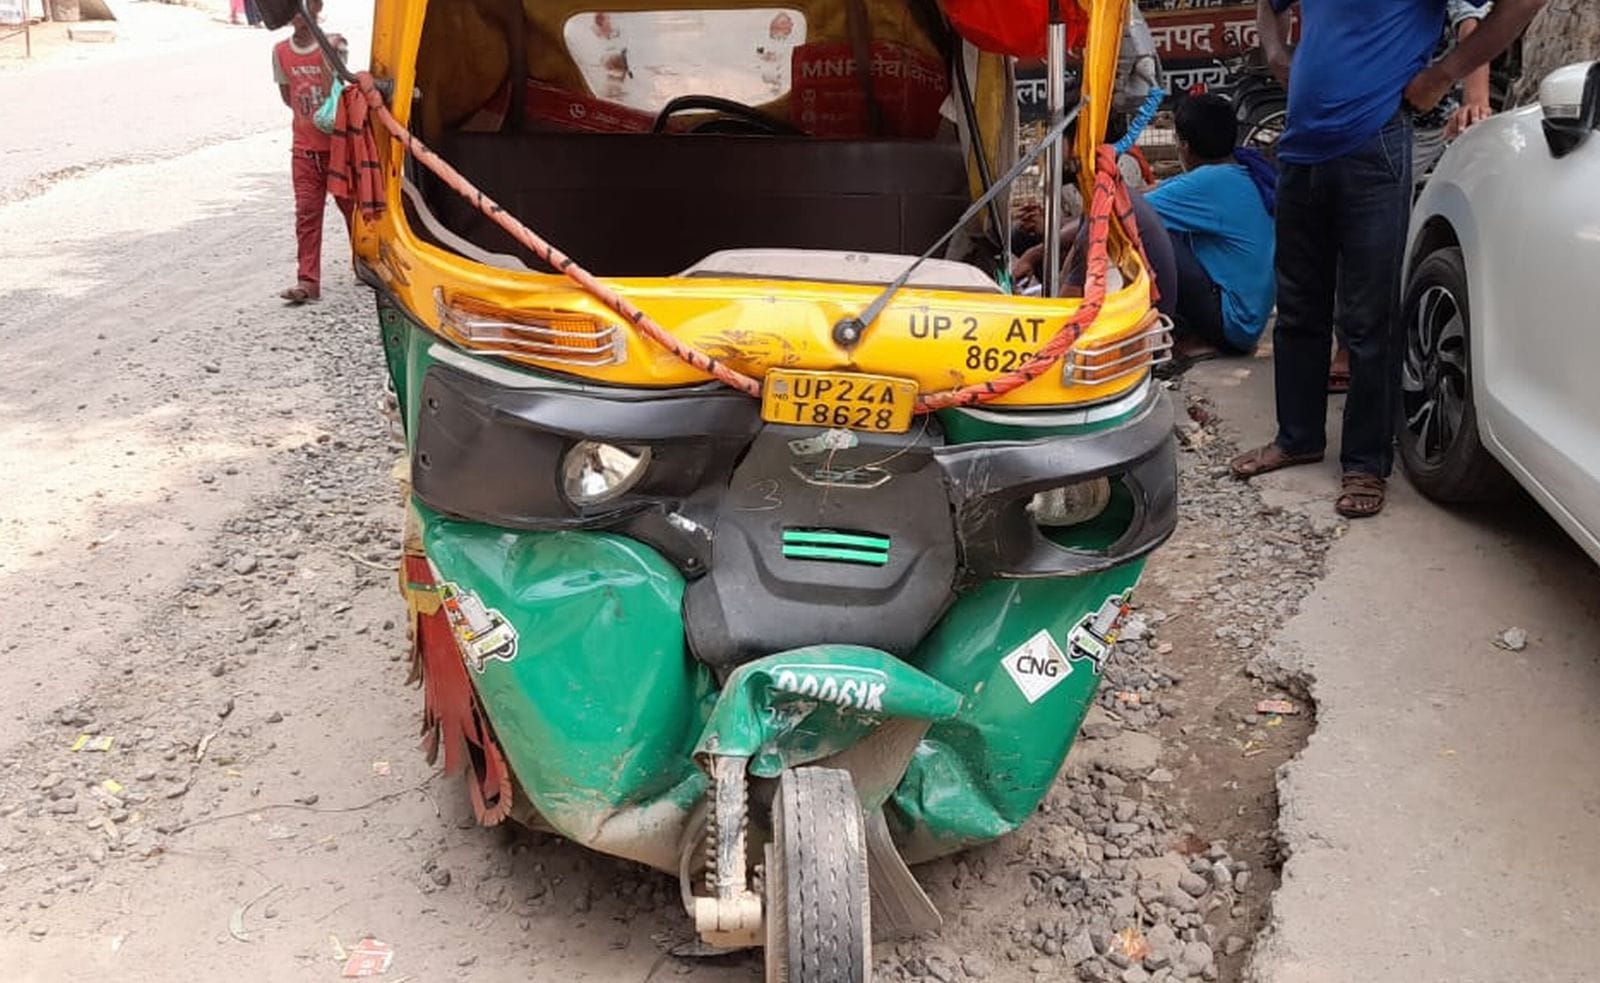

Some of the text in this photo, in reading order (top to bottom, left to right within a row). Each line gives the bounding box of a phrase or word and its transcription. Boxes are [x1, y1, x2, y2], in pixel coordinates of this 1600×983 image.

[1150, 23, 1215, 51] नपद
[1005, 318, 1045, 343] AT
[793, 378, 895, 405] UP24A
[793, 402, 893, 430] T8628
[1016, 654, 1059, 678] CNG
